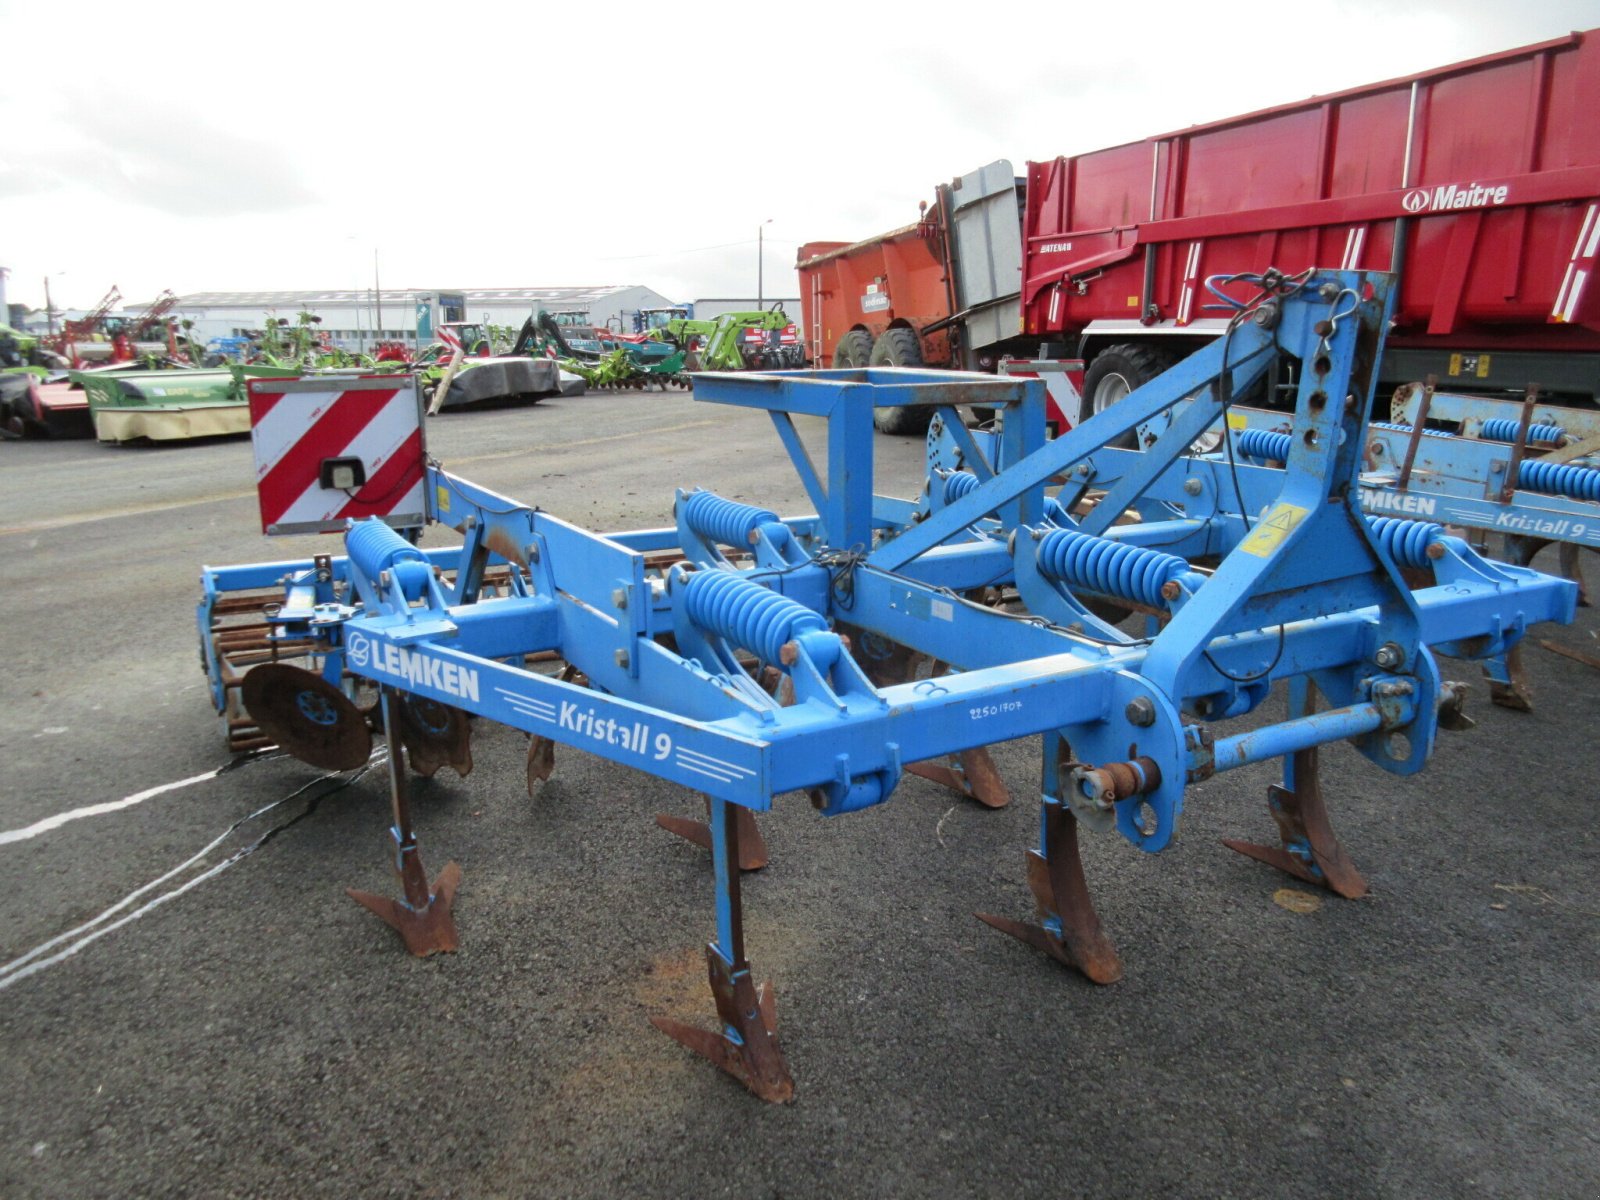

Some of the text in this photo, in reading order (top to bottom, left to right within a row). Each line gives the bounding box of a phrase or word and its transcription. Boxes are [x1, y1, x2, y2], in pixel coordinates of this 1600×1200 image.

[1432, 182, 1508, 211] Maitre
[1496, 511, 1587, 538] Kristall 9
[371, 639, 480, 703] LEMKEN
[559, 700, 672, 760] Kristall 9
